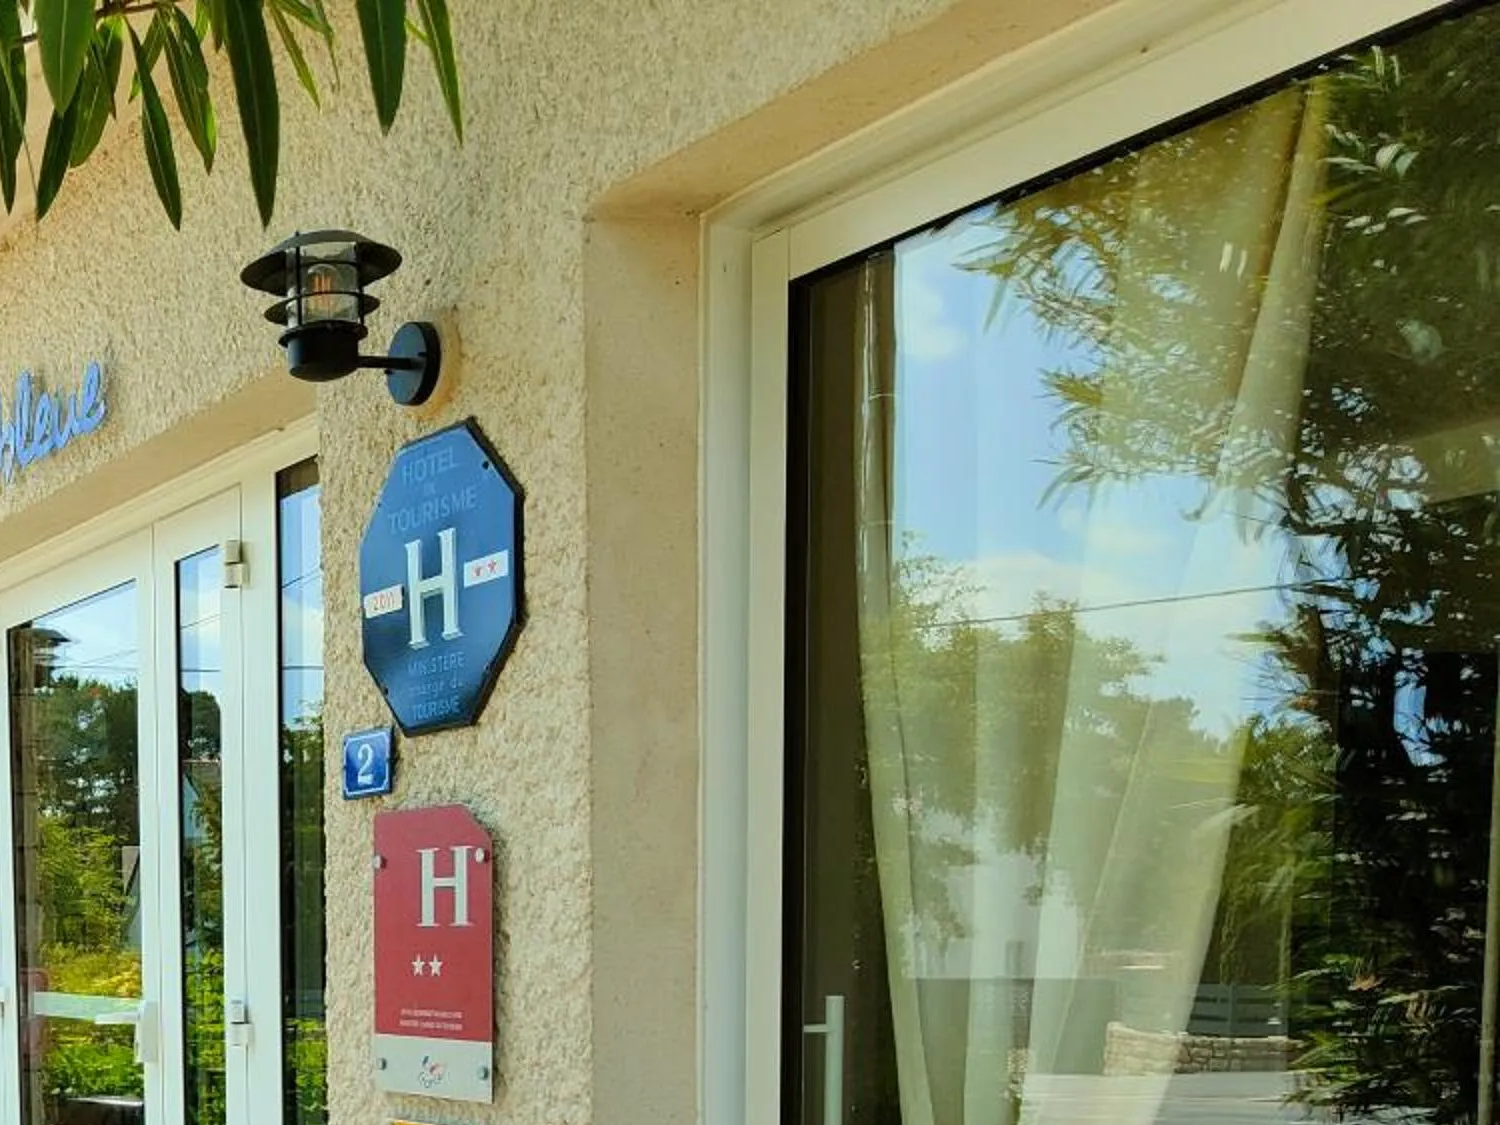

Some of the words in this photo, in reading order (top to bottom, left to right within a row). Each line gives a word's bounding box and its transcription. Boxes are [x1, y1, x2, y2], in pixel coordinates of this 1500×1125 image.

[388, 484, 477, 534] TOURISME
[404, 527, 464, 650] H
[357, 743, 373, 785] 2
[417, 846, 475, 927] H
